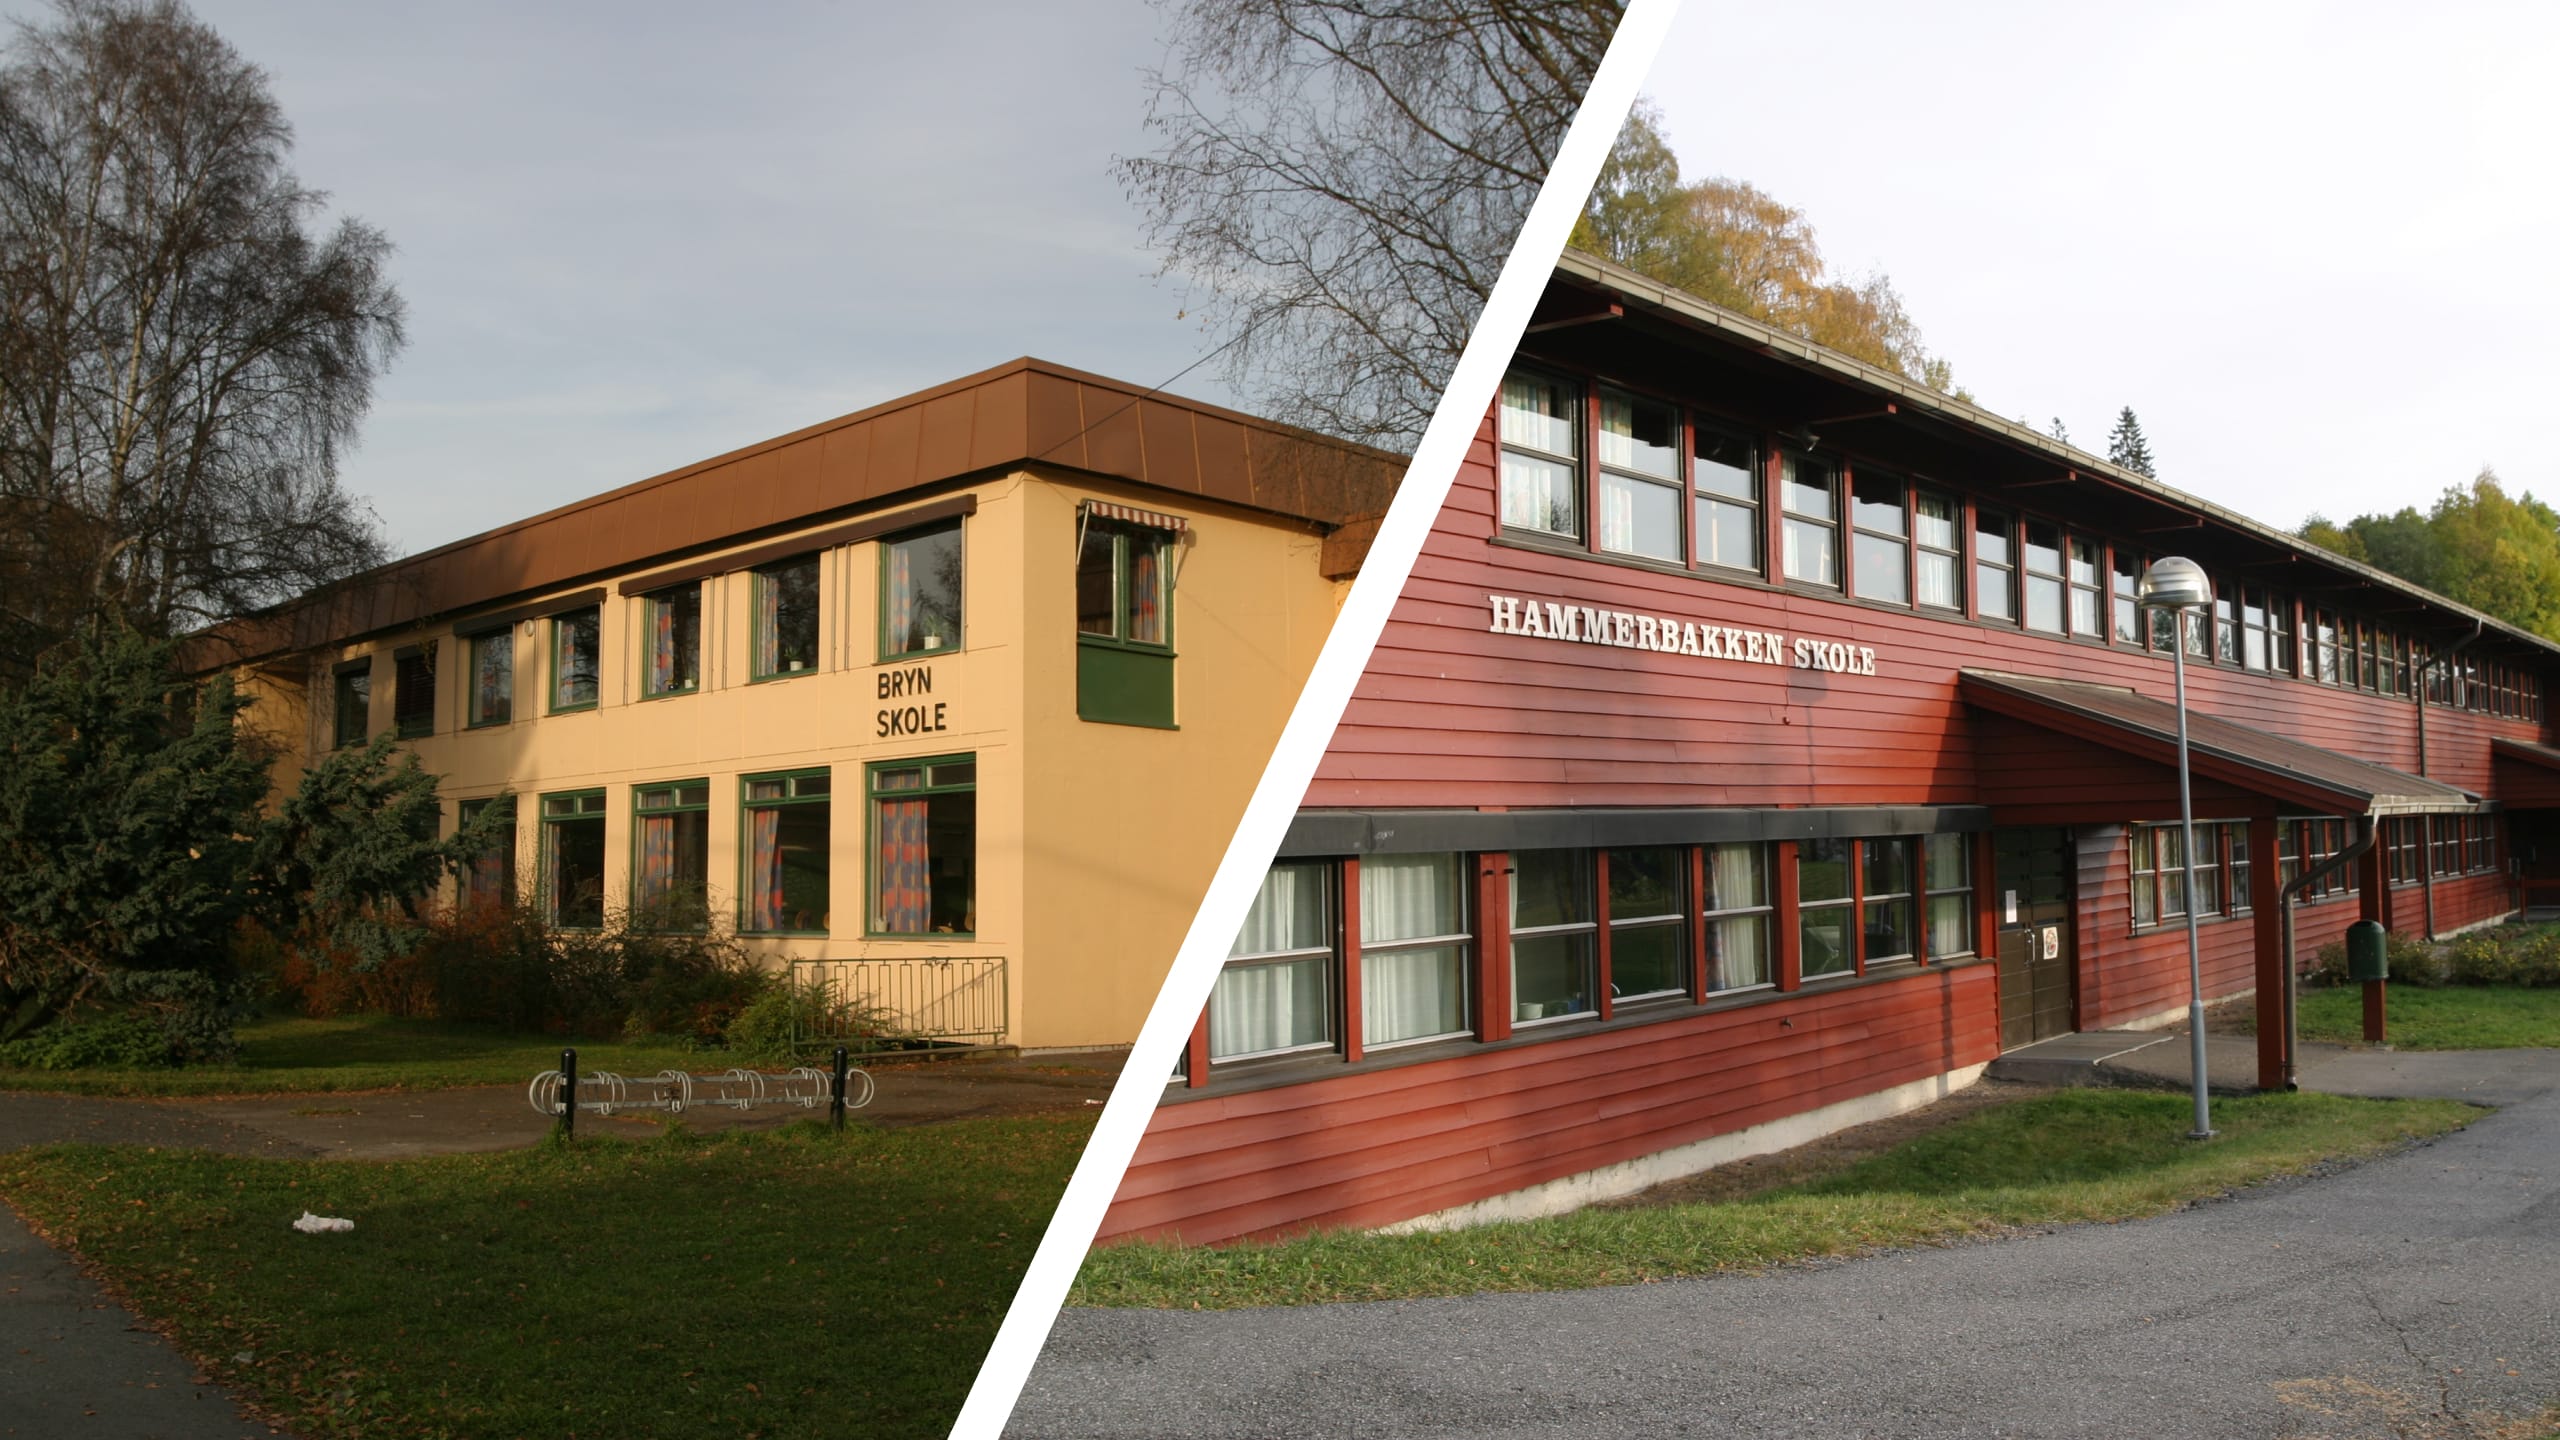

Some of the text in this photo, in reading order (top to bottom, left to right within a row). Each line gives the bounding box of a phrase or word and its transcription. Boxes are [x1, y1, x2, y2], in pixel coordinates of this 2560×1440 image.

[1489, 595, 1876, 676] HAMMERBAKKEN SKOLE
[877, 666, 931, 699] BRYN
[876, 702, 947, 737] SKOLE
